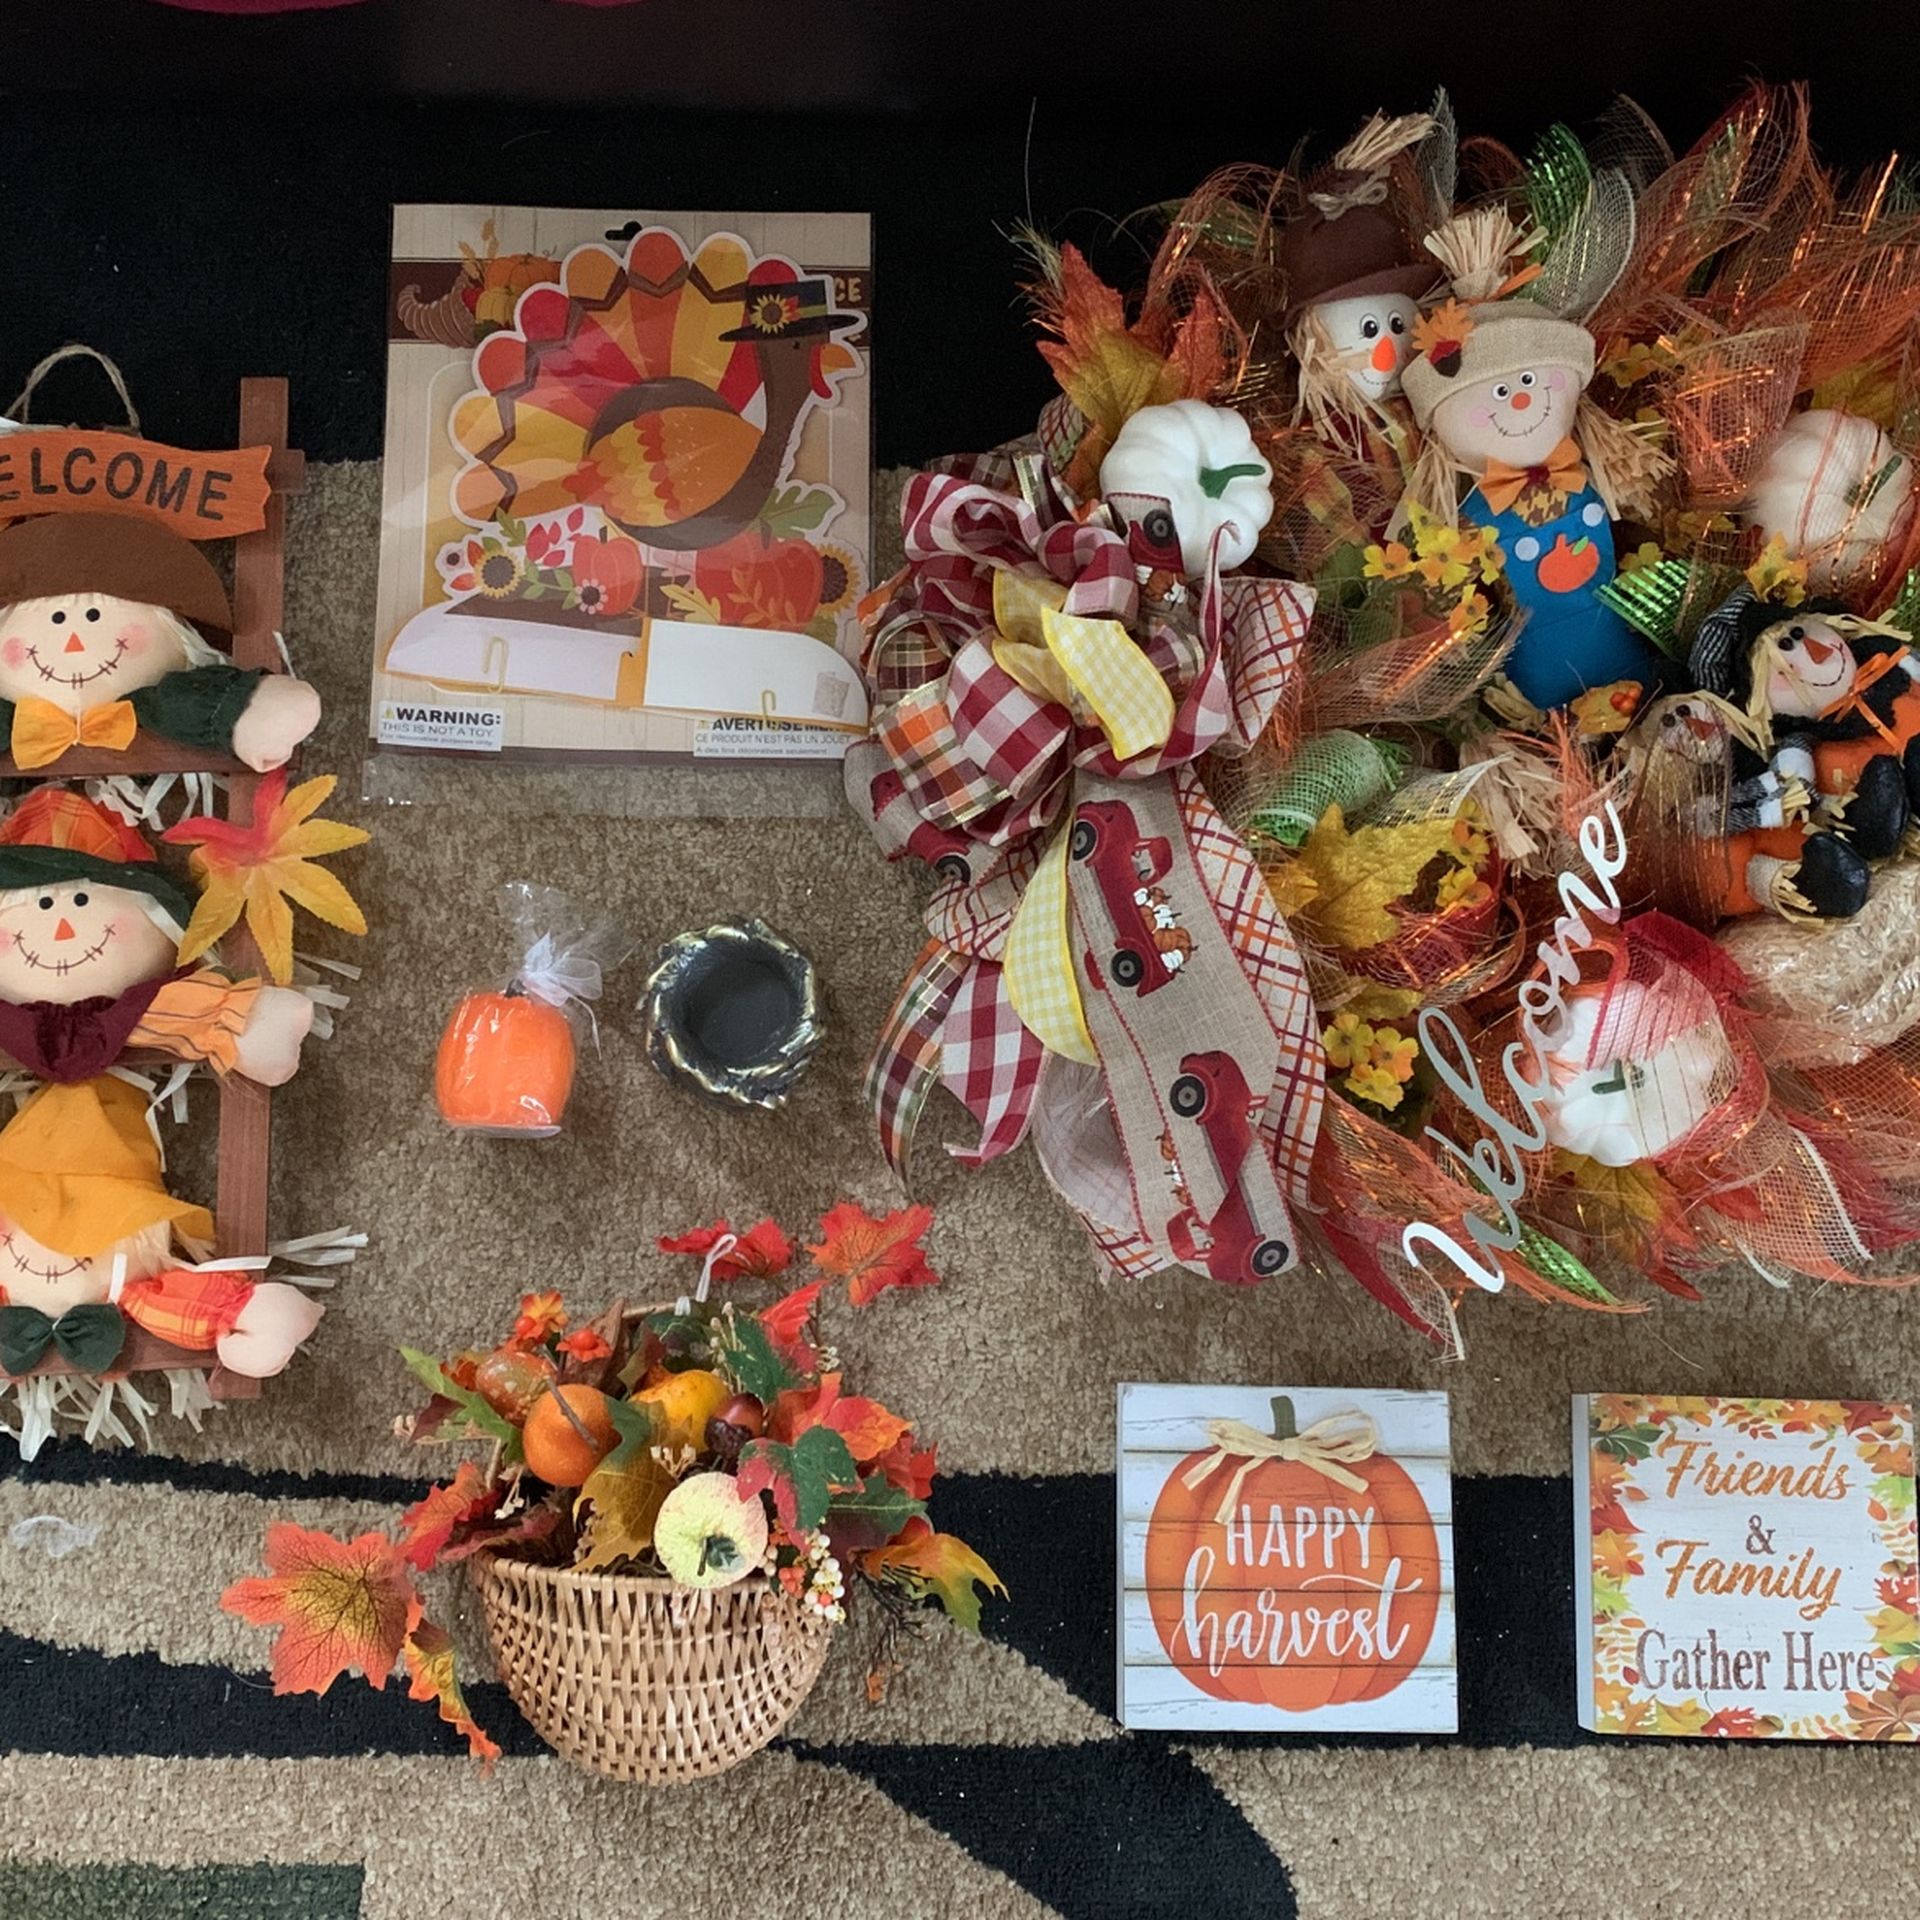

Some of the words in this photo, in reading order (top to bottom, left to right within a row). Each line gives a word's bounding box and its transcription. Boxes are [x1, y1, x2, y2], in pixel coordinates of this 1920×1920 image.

[382, 722, 410, 733] THIS
[413, 724, 425, 734] IS
[428, 725, 454, 735] NOT
[456, 727, 466, 736] A
[396, 707, 501, 726] WARNING:
[695, 733, 708, 743] CE
[711, 734, 752, 744] PRODUIT
[784, 735, 803, 744] PAS
[805, 735, 819, 744] UN
[821, 735, 852, 745] JOUET
[1656, 1434, 1855, 1500] Friends
[1226, 1504, 1374, 1569] HAPPY
[1745, 1514, 1776, 1555] &
[1170, 1546, 1423, 1678] harvest
[1655, 1540, 1842, 1621] Family
[1636, 1628, 1770, 1691] Gather
[1782, 1631, 1876, 1692] Here
